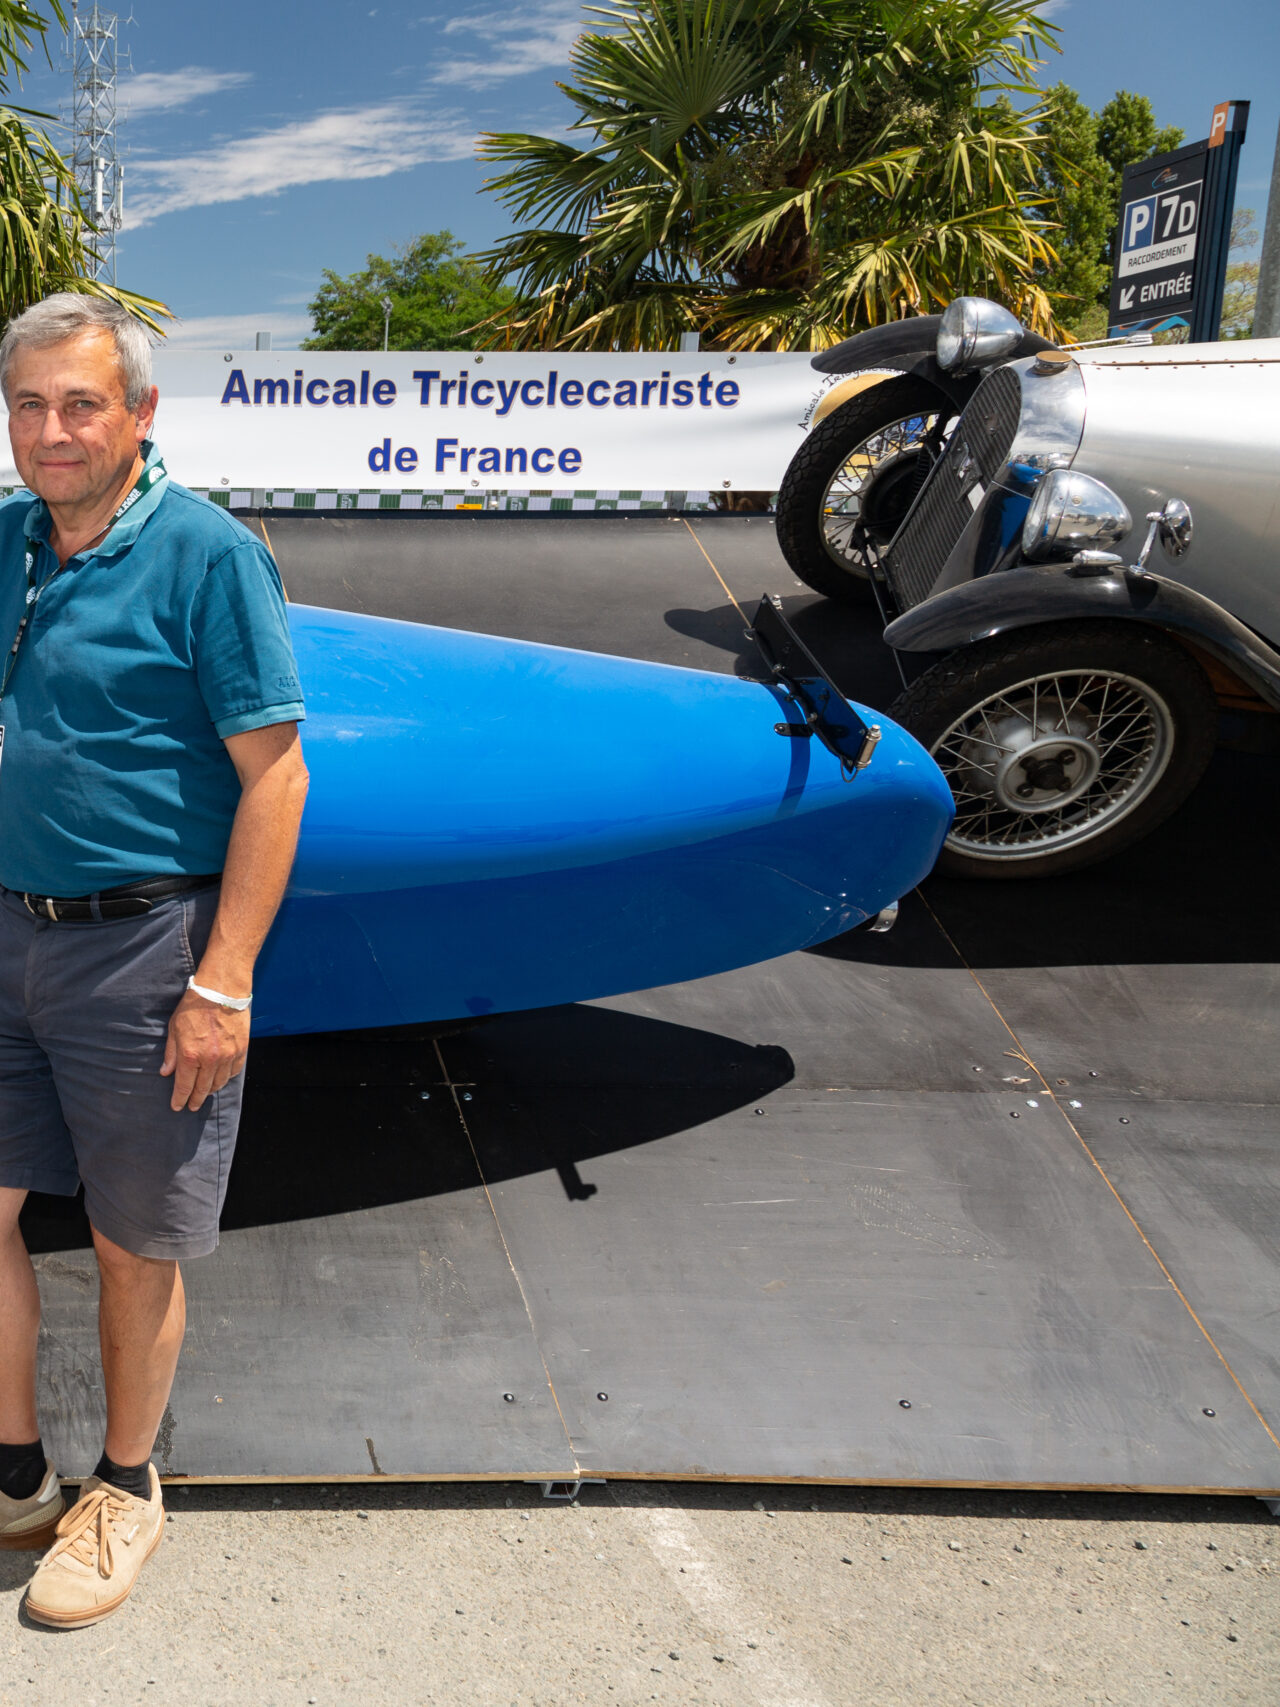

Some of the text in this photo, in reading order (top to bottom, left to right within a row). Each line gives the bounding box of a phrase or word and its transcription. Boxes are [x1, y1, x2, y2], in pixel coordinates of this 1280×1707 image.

[1211, 112, 1226, 137] P
[1128, 195, 1196, 247] P 7D
[1127, 244, 1188, 268] RACCORDEMENT
[1140, 271, 1192, 303] ENTRÉE
[222, 370, 739, 415] Amicale Tricyclecariste
[797, 388, 825, 432] Amicale
[368, 438, 581, 473] de France
